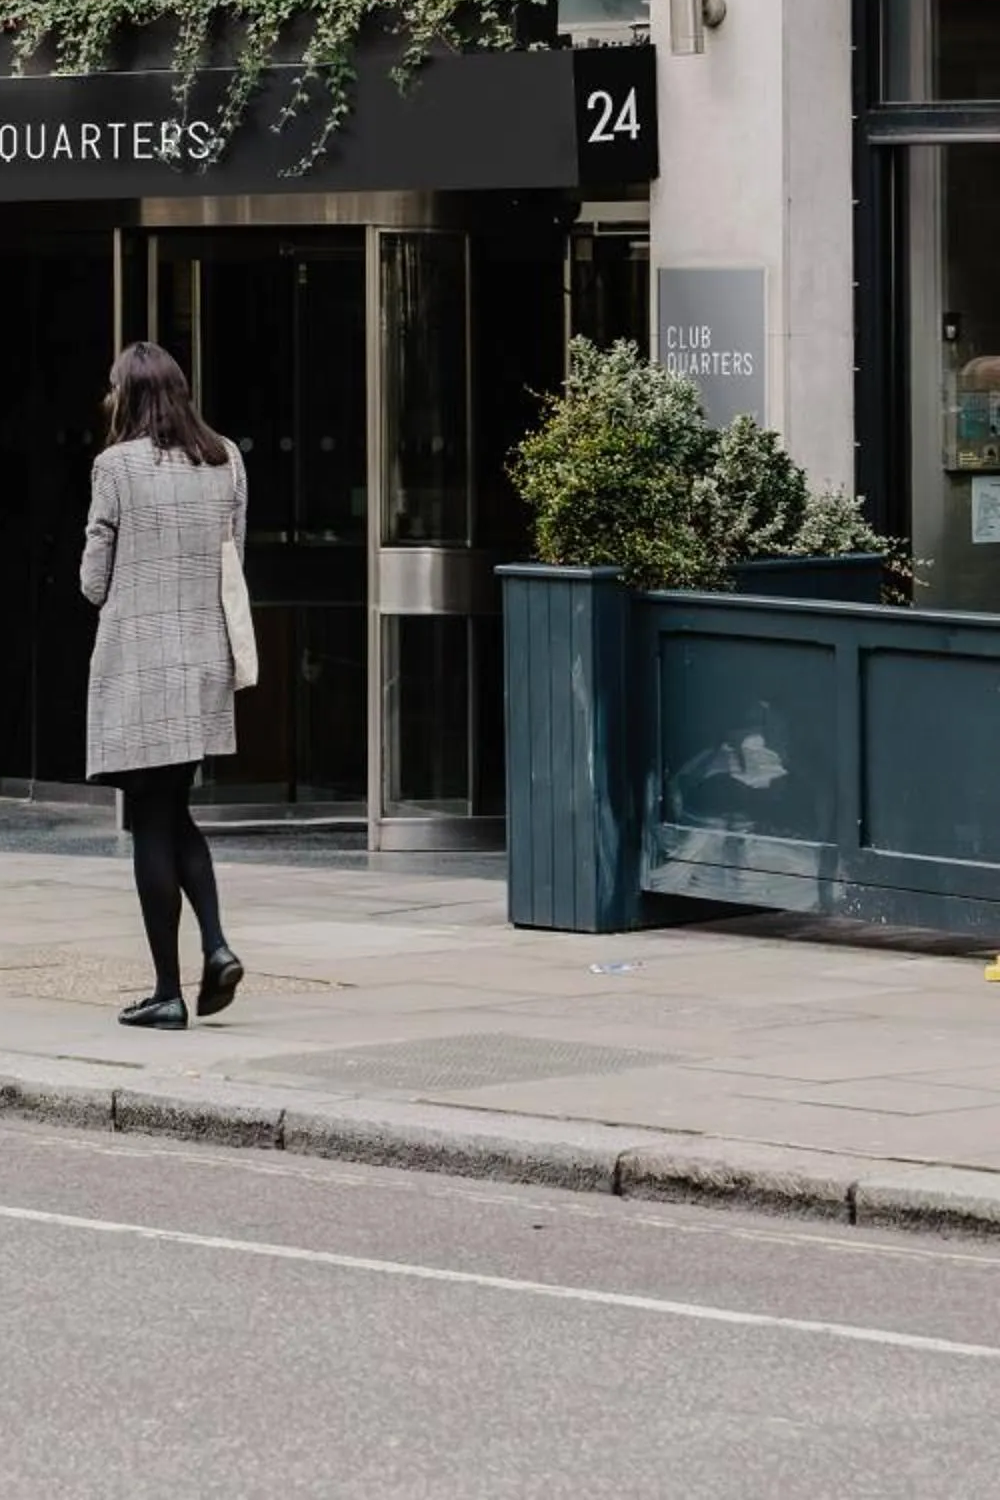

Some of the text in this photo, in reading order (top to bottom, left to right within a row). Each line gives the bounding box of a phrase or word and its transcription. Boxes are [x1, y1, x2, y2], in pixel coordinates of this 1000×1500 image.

[587, 86, 641, 143] 24
[667, 325, 712, 349] CLUB
[667, 352, 753, 376] QUARTERS
